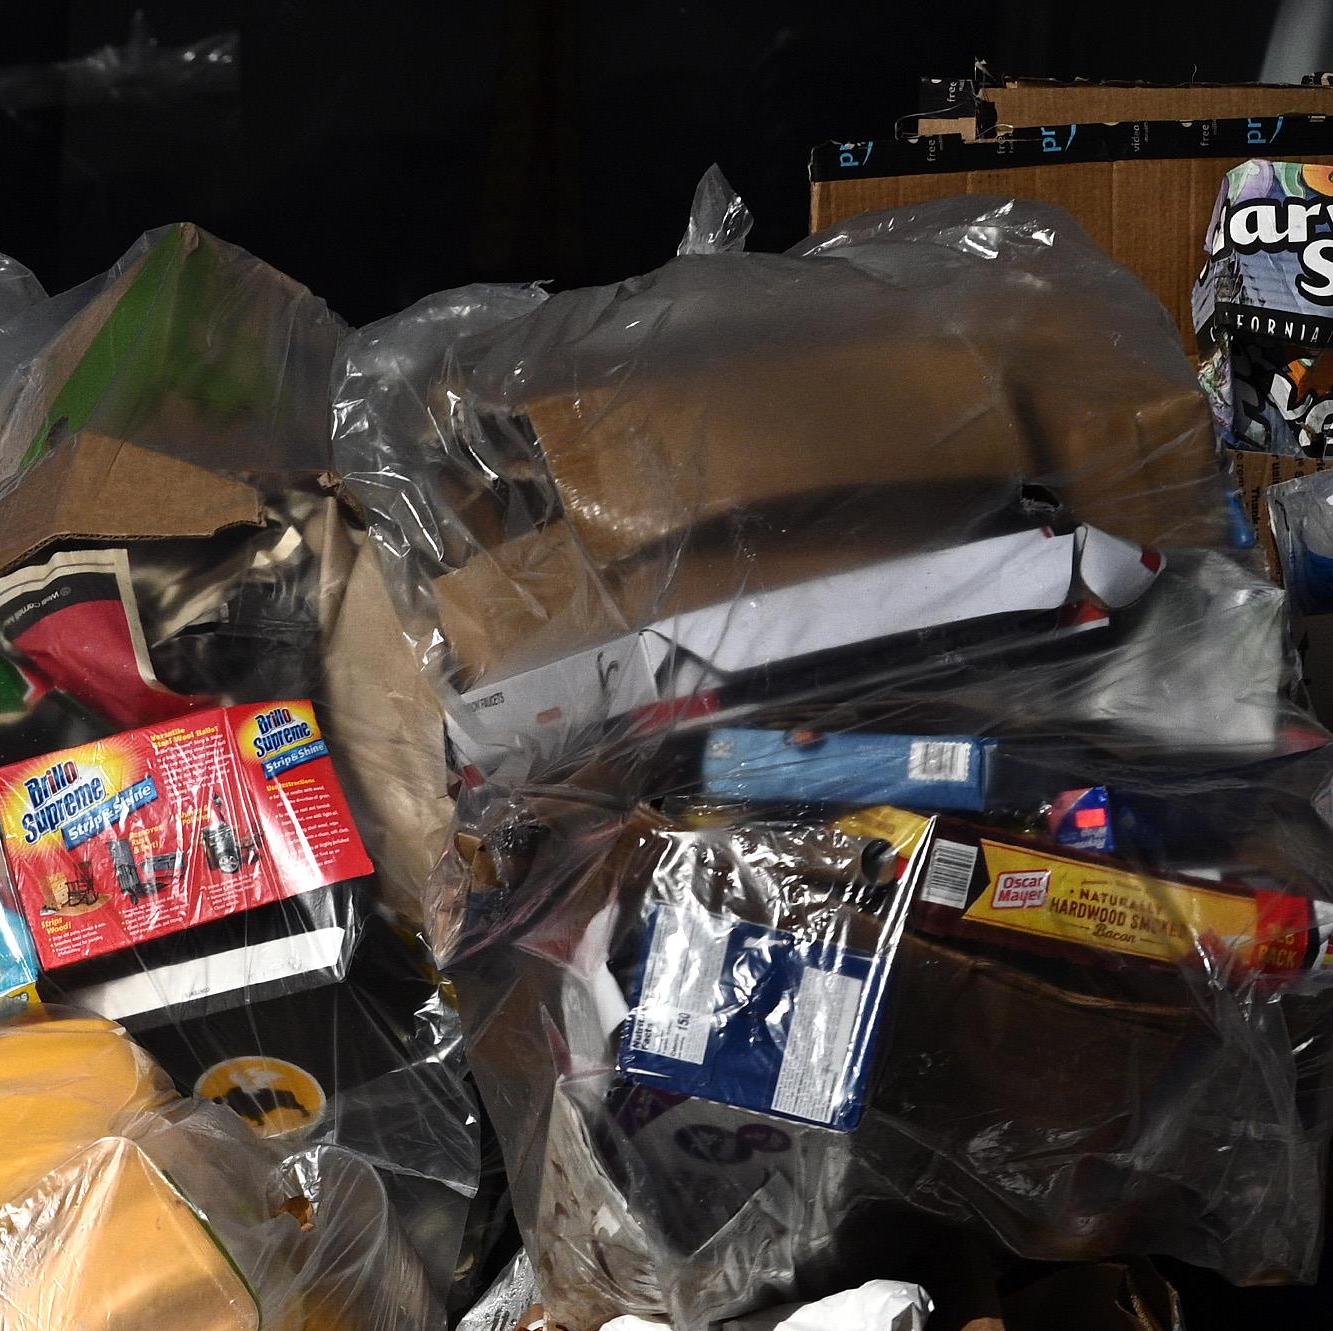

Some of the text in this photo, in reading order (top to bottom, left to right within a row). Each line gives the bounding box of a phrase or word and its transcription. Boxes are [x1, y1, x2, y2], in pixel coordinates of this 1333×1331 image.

[946, 81, 958, 102] free
[1199, 123, 1211, 147] free
[254, 708, 293, 736] Brillo
[253, 721, 311, 758] Supreme
[265, 744, 325, 773] Strip&Shine
[24, 760, 79, 809] Brillo
[21, 777, 107, 844] Supreme
[1003, 874, 1043, 890] Oscar
[997, 887, 1045, 903] Mayer
[1048, 896, 1126, 926] HARDWOOD
[40, 917, 64, 929] Strips
[45, 922, 72, 935] Wood!
[1092, 923, 1137, 944] Bacon
[675, 1011, 691, 1031] 150
